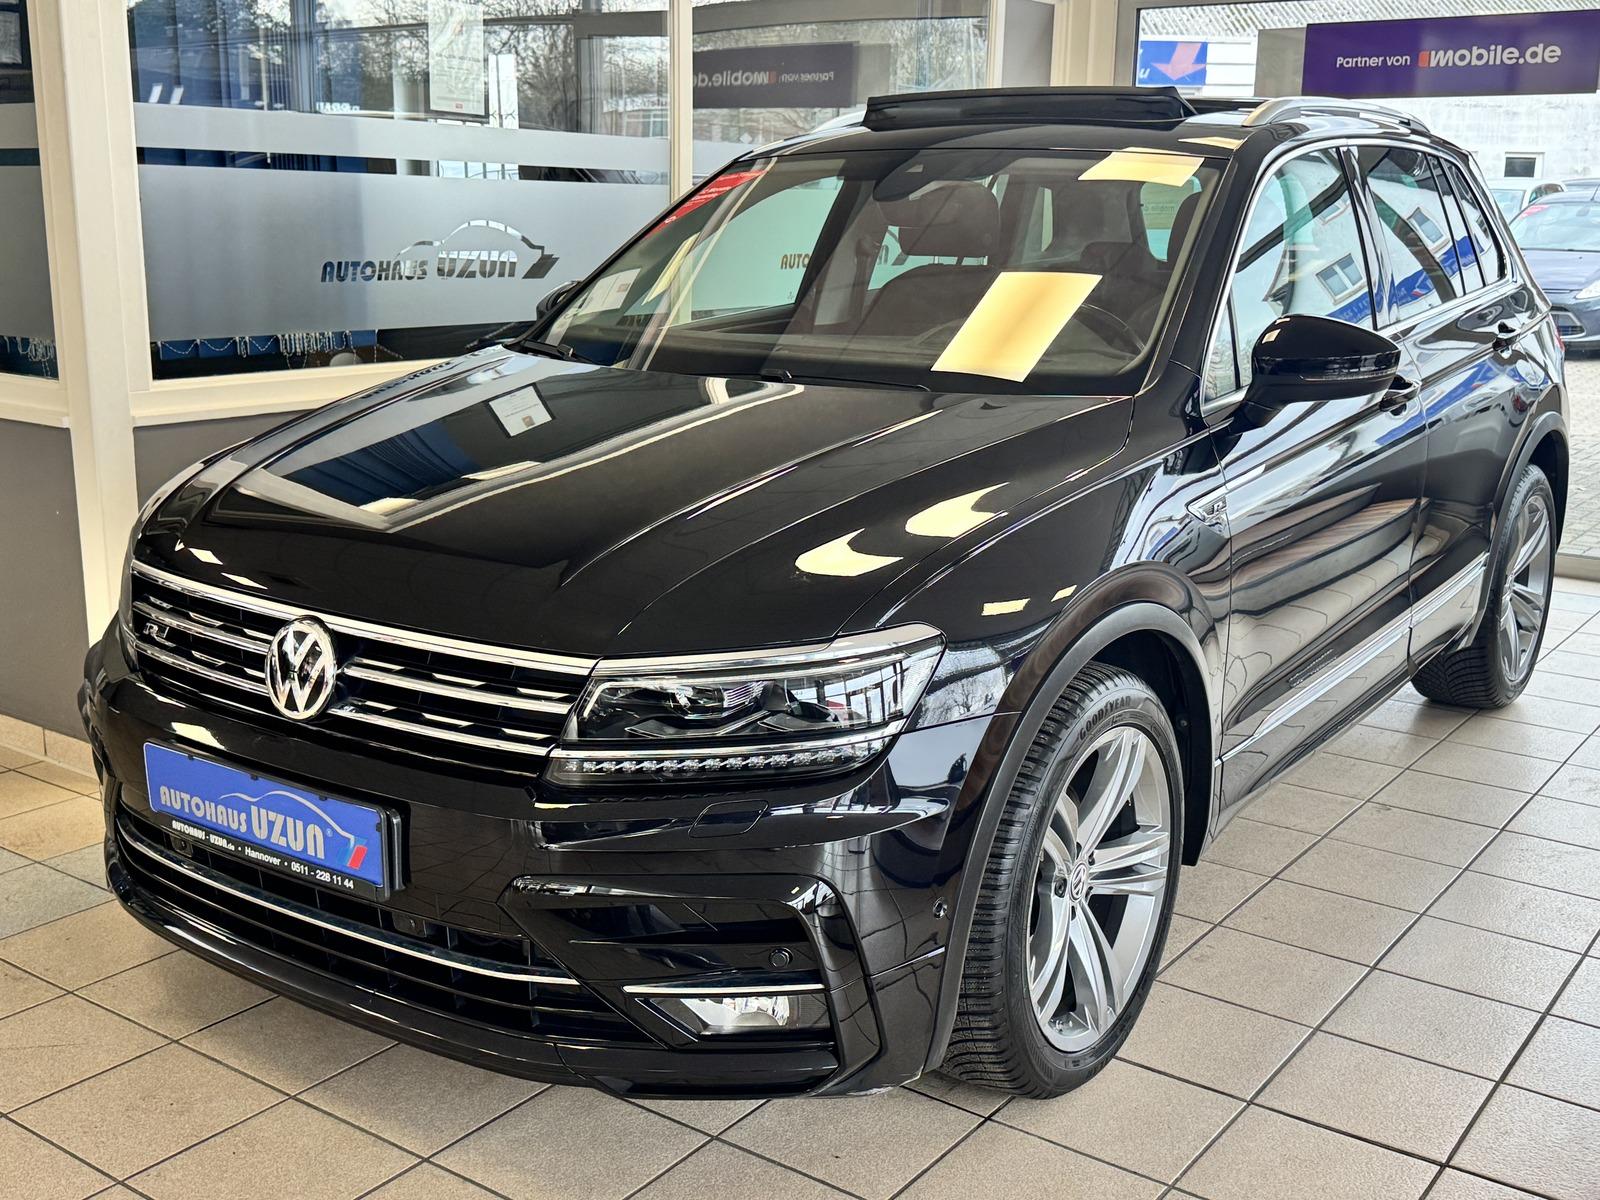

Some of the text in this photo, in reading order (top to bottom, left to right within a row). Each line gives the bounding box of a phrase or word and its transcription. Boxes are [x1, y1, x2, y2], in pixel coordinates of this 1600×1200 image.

[1336, 43, 1562, 68] Partner von mobile.de
[320, 249, 518, 283] AUTOHAUS UZUN
[780, 253, 811, 270] AUTO
[1079, 695, 1131, 741] GOODYEAR
[159, 785, 325, 859] AUTOHAUS UZUN
[245, 847, 281, 866] Hannover
[291, 861, 308, 876] 0511
[315, 869, 331, 883] 228
[332, 873, 342, 885] 11
[343, 876, 354, 890] 44
